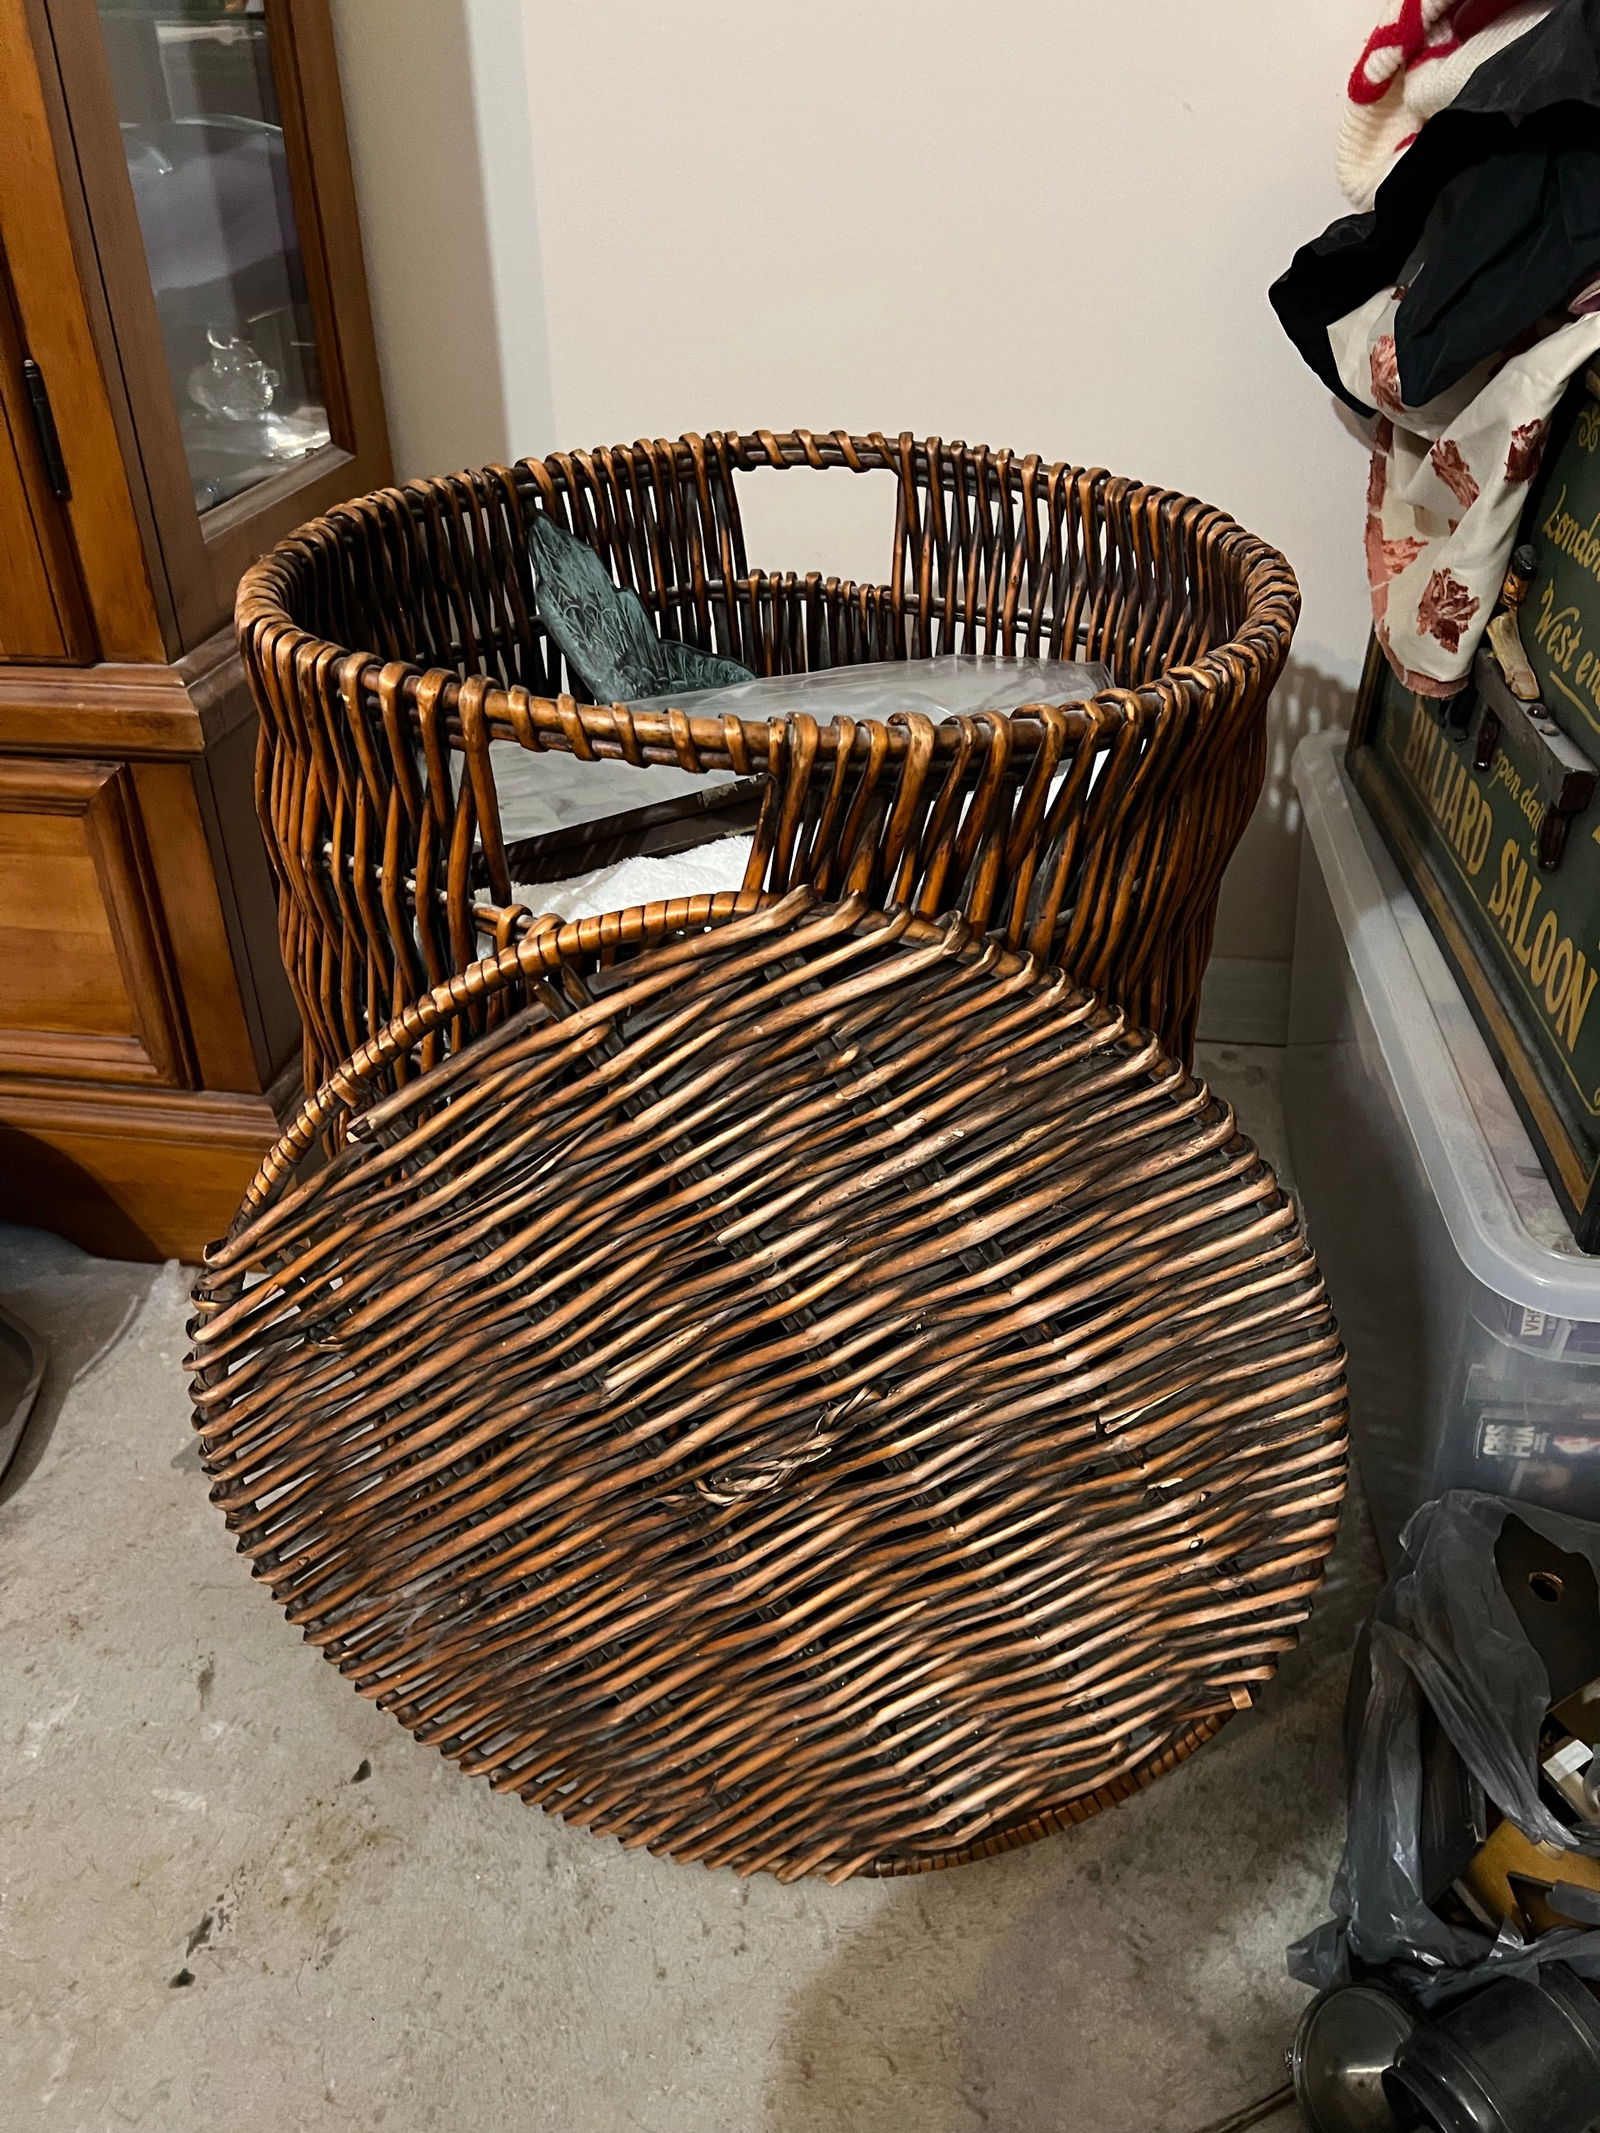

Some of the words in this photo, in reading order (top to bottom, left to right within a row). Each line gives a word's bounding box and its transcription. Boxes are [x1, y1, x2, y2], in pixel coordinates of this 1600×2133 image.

[1534, 578, 1582, 673] West
[1575, 650, 1600, 711] en
[1403, 694, 1493, 876] BILLIARD
[1488, 838, 1598, 1053] SALOON
